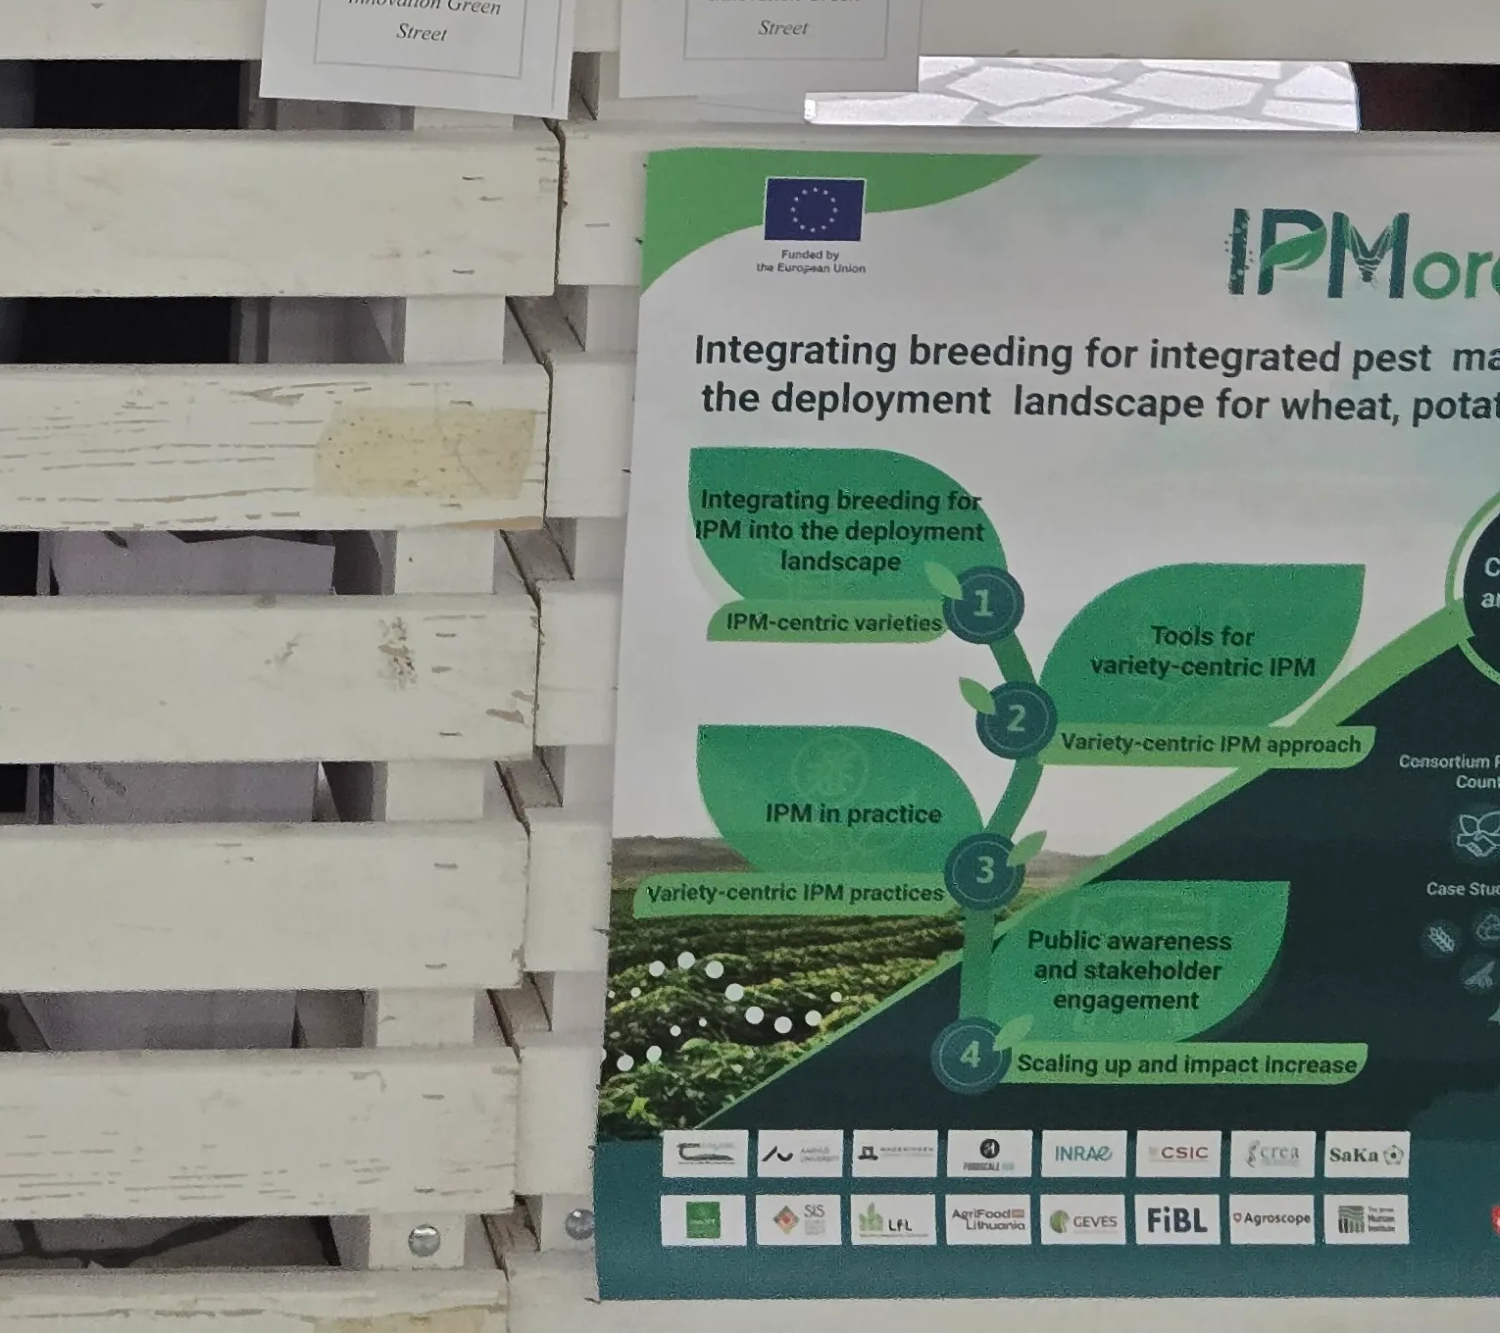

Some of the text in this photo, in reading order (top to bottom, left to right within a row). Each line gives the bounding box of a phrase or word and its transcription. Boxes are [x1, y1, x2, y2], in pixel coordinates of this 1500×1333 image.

[396, 21, 448, 43] Street
[757, 18, 811, 37] Street
[781, 249, 840, 263] Funded by
[1228, 208, 1499, 300] IPMor
[756, 262, 867, 275] the European Union
[696, 334, 897, 372] Integrating
[909, 334, 1073, 376] breeding
[1085, 337, 1139, 368] for
[1149, 338, 1341, 378] integrated
[1352, 343, 1432, 380] pest
[701, 381, 760, 413] the
[771, 381, 992, 421] deployment
[1014, 383, 1205, 426] landscape
[1216, 387, 1270, 420] for
[1280, 388, 1401, 427] wheat,
[700, 489, 982, 515] Integrating breeding for
[695, 519, 985, 545] IPM into the deployment
[781, 549, 901, 575] landscape
[974, 589, 994, 617] 1
[726, 612, 944, 633] IPM-centric varieties
[1150, 624, 1256, 647] Tools for
[1090, 656, 1316, 681] variety-centric IPM
[1006, 704, 1027, 732] 2
[1060, 733, 1362, 759] Variety-centric IPM approach
[1399, 753, 1490, 769] Consortium
[765, 803, 943, 826] IPM in practice
[975, 856, 995, 884] 3
[647, 883, 945, 906] Variety-centric IPM practices
[1426, 881, 1466, 896] Case
[1027, 929, 1233, 952] Public awareness
[1033, 959, 1223, 982] and stakeholder
[1053, 991, 1200, 1015] engagement
[960, 1040, 982, 1069] 4
[1017, 1053, 1358, 1079] Scaling up and impact increase
[1161, 1146, 1209, 1159] CSIC
[1259, 1146, 1300, 1160] crea
[1329, 1147, 1379, 1163] SaKa
[952, 1208, 1011, 1221] AgriFood
[966, 1219, 1026, 1231] Lithuania
[1073, 1215, 1118, 1228] GEVES
[1148, 1205, 1208, 1233] FiBL
[1244, 1212, 1311, 1226] Agroscope
